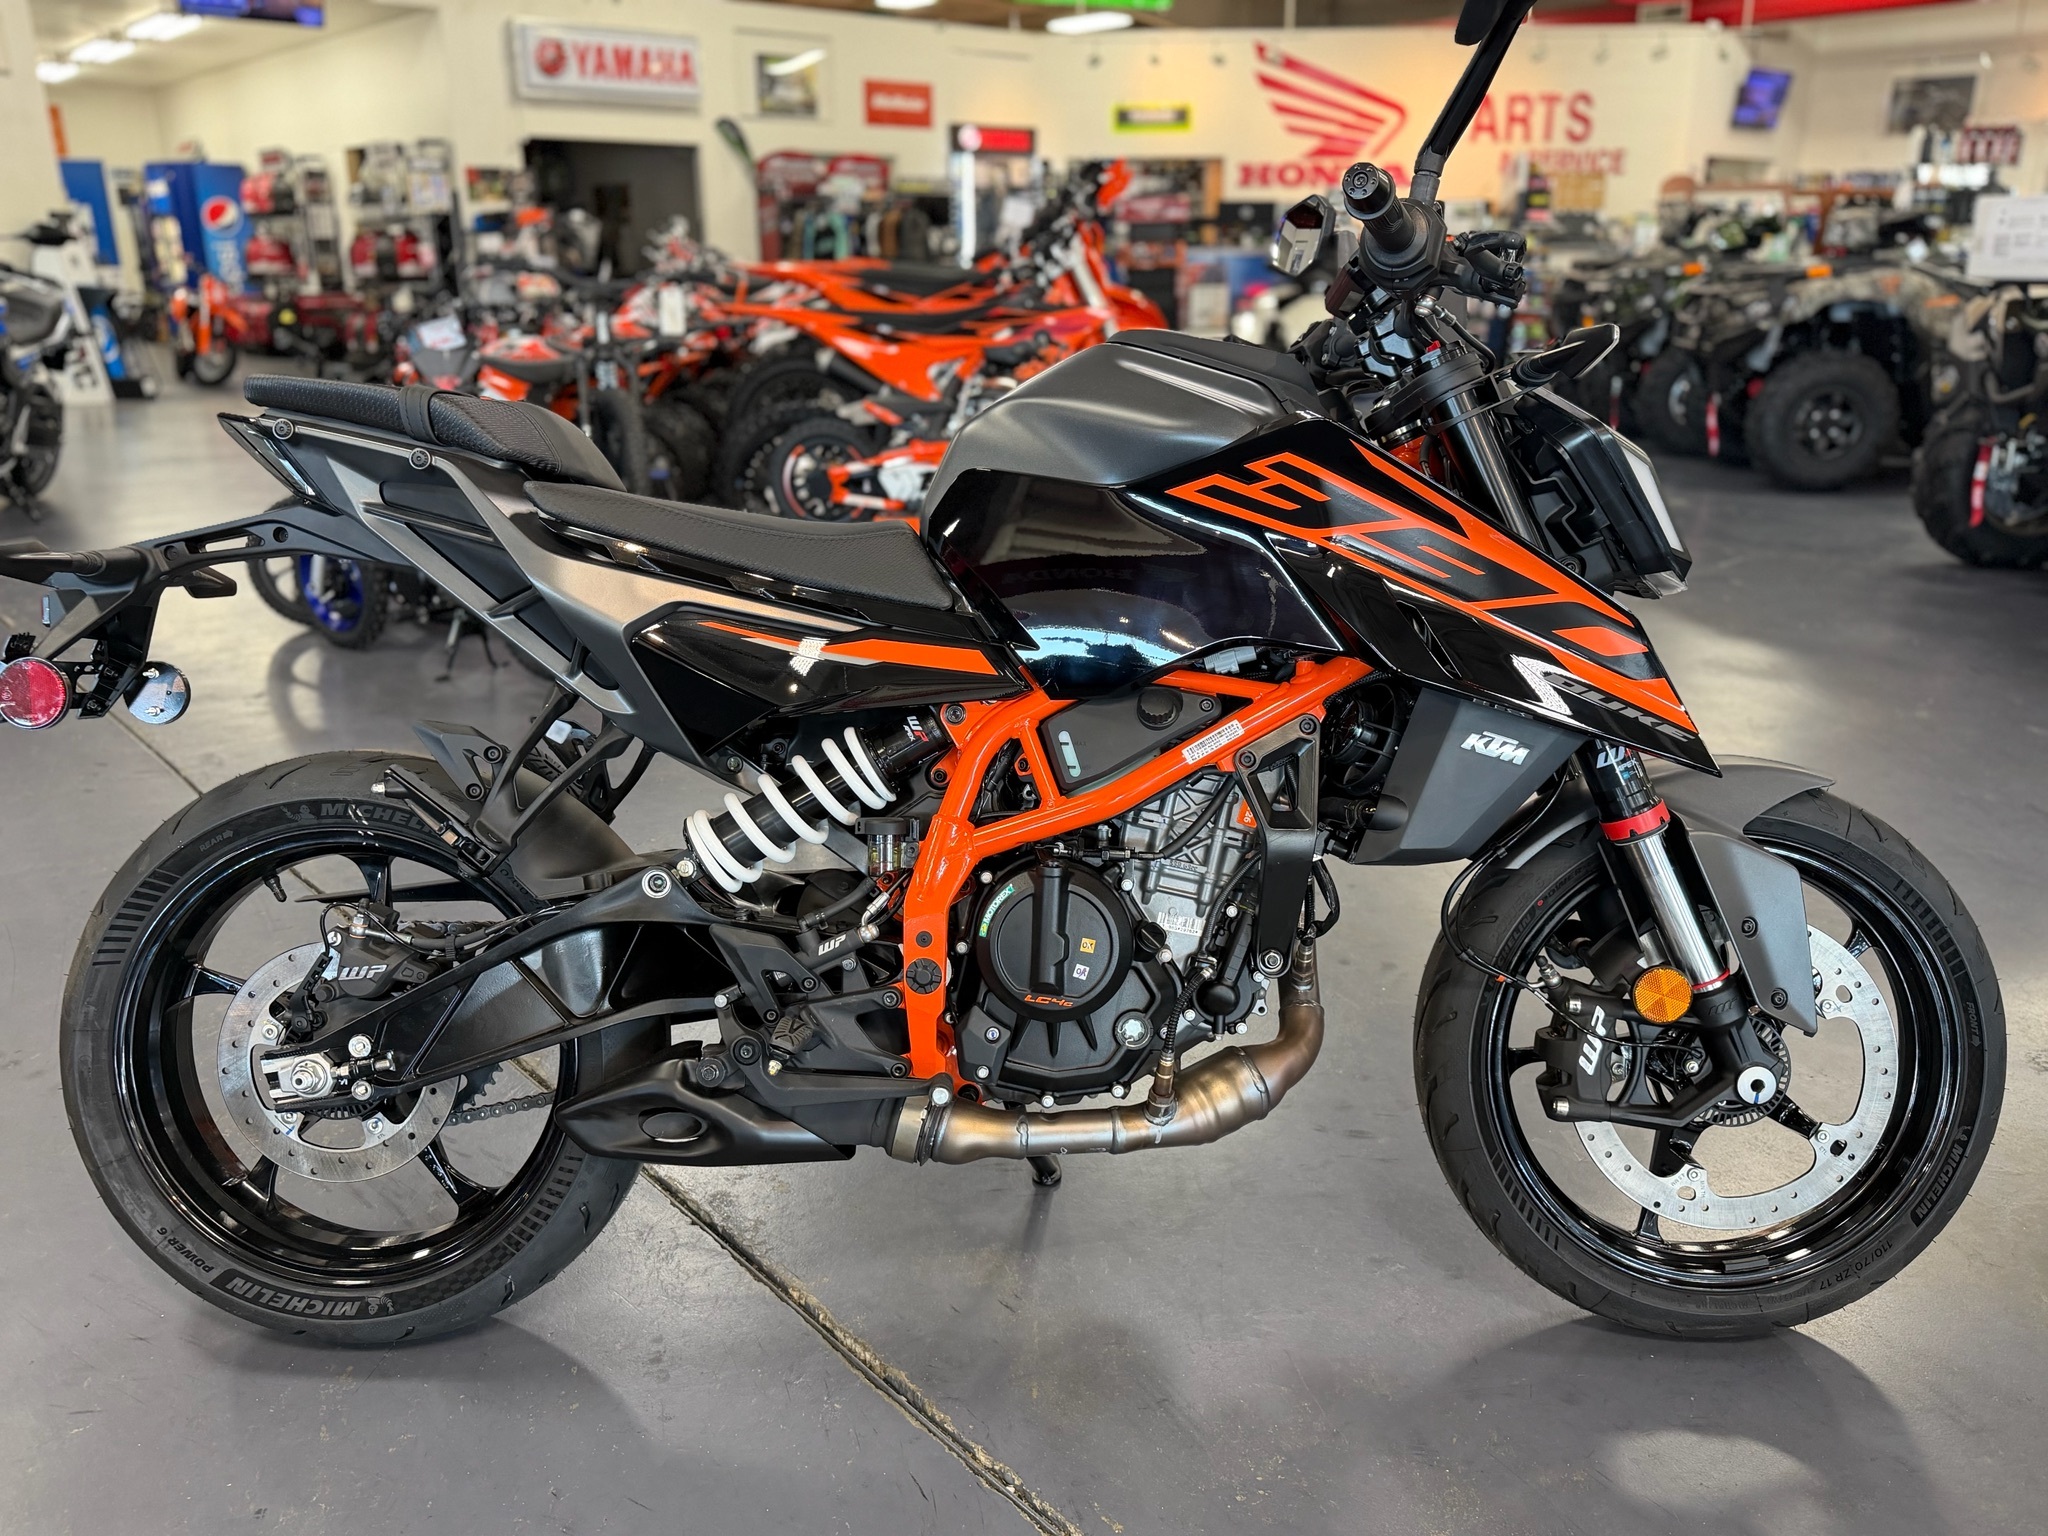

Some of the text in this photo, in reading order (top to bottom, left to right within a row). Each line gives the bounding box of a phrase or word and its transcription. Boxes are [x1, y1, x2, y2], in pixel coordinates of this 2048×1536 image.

[572, 42, 698, 86] YAMAHA
[1469, 92, 1594, 143] ARTS
[1238, 163, 1411, 187] HONA
[1543, 672, 1696, 743] DUKE
[907, 716, 929, 742] WP
[1461, 731, 1531, 766] KTM
[200, 833, 223, 852] REAR
[984, 886, 1012, 924] MOTOREX
[818, 934, 847, 956] WP
[1082, 940, 1095, 950] OK
[338, 965, 388, 981] WP
[1966, 1002, 1980, 1035] FRONT
[1578, 1005, 1607, 1076] WP
[1916, 1143, 1965, 1220] MICHELIN
[156, 1226, 214, 1274] POWER 6
[1818, 1240, 1893, 1291] 110/70 ZR 17
[225, 1276, 361, 1317] MICHELIN
